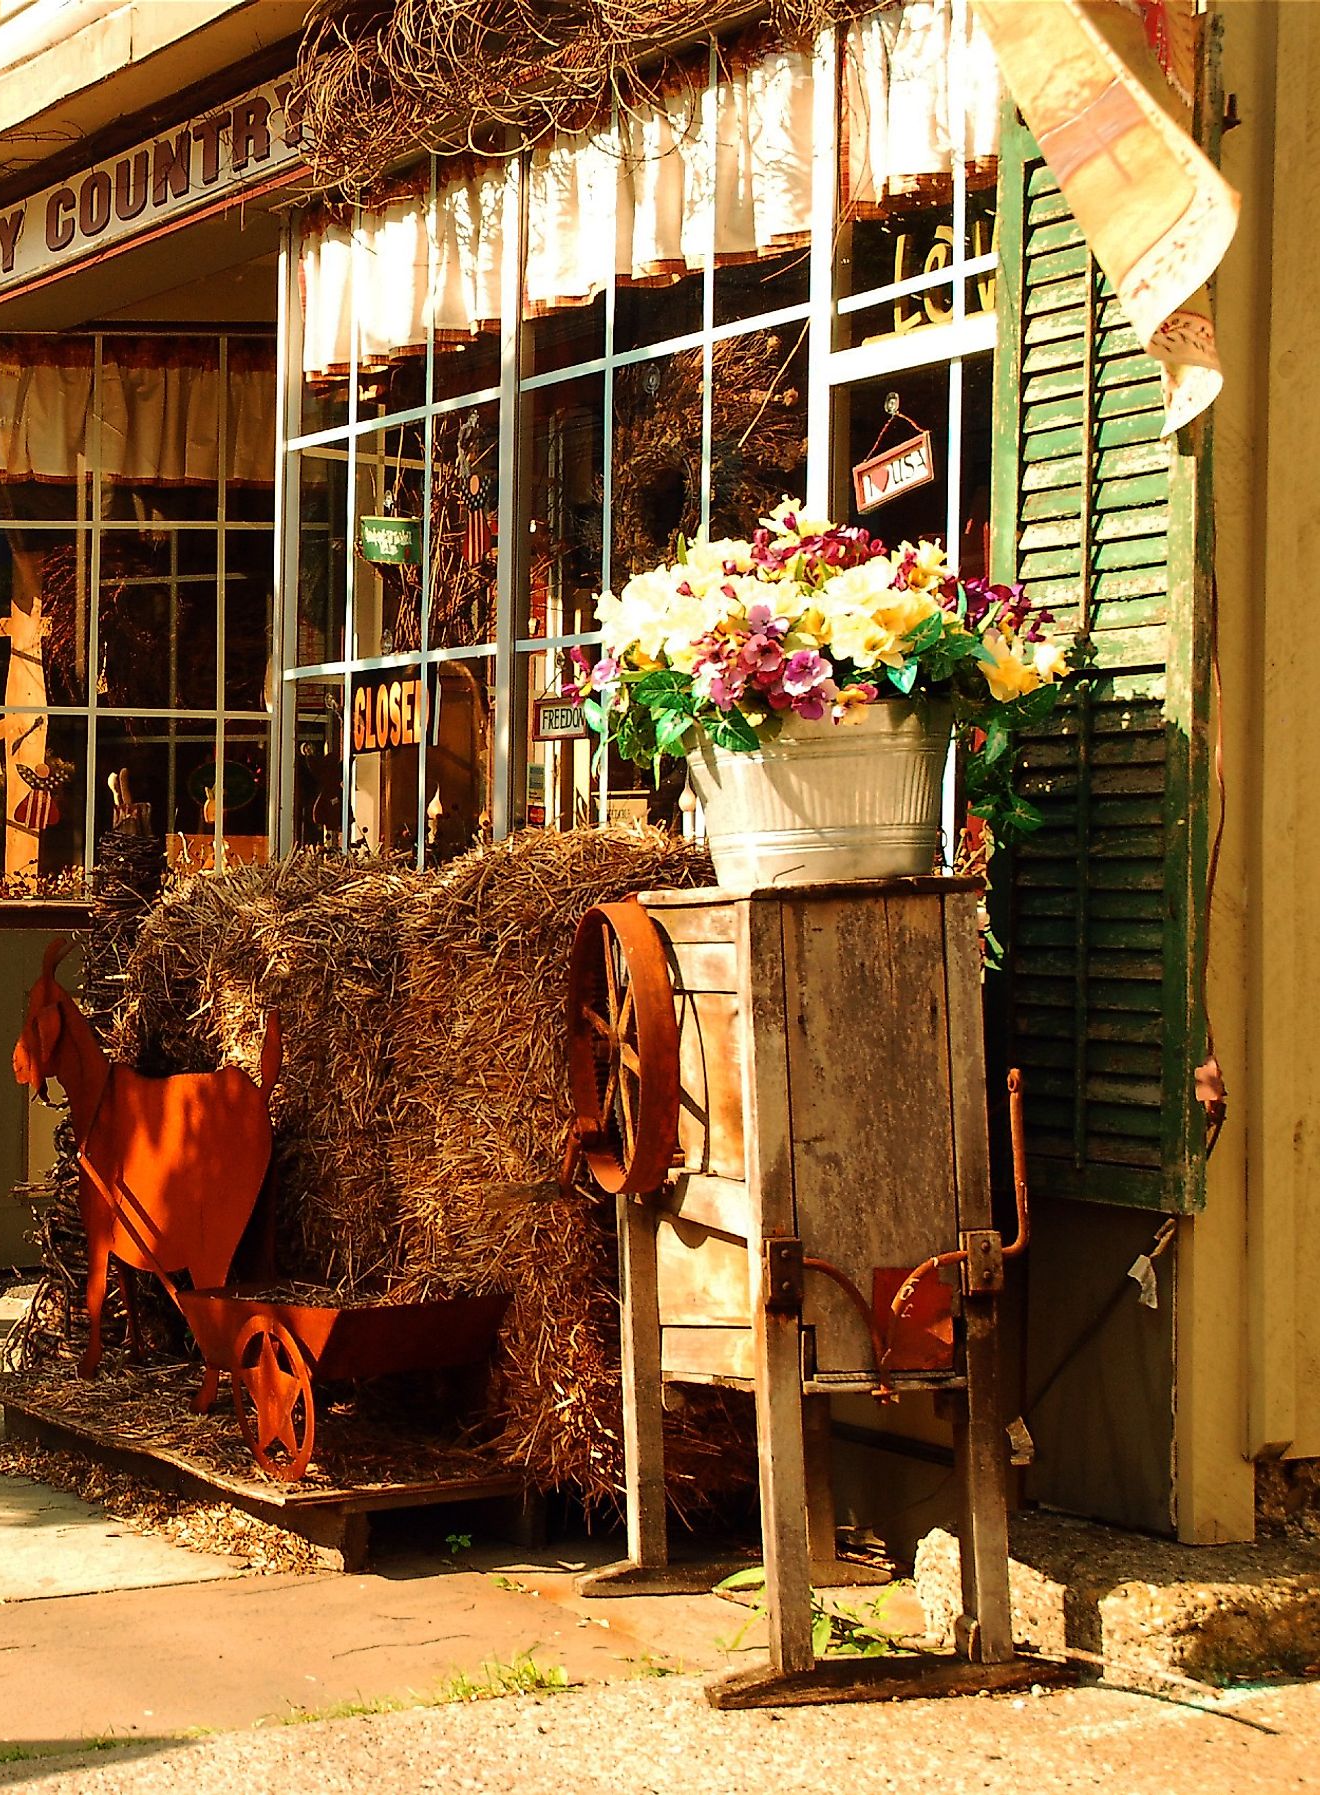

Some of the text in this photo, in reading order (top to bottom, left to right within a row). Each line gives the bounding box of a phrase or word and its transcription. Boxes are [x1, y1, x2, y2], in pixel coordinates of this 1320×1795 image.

[45, 82, 305, 252] COUNTRY
[890, 449, 927, 485] USA
[354, 679, 430, 751] CLOSED
